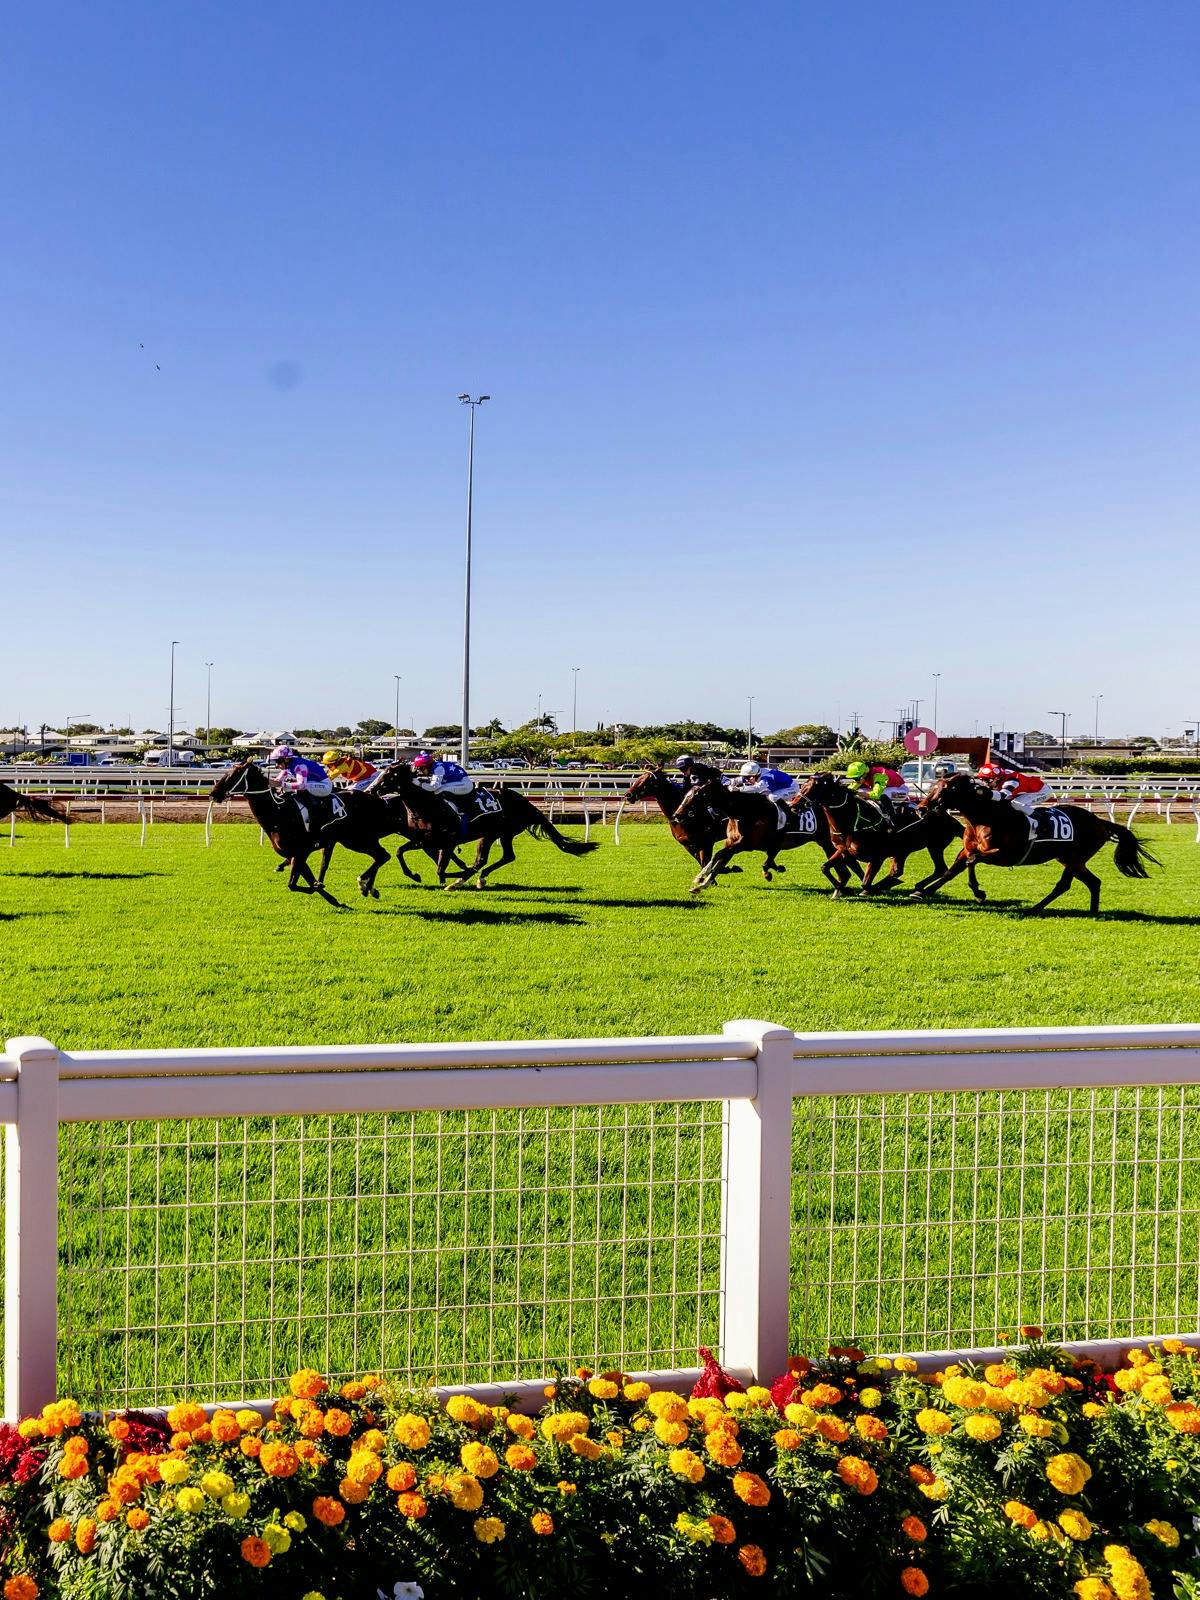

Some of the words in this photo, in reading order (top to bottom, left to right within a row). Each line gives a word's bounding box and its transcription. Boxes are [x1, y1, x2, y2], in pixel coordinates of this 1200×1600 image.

[913, 732, 927, 752] 1
[332, 798, 344, 817] 4
[475, 798, 498, 813] 14
[799, 810, 815, 832] 18
[1050, 815, 1071, 839] 16
